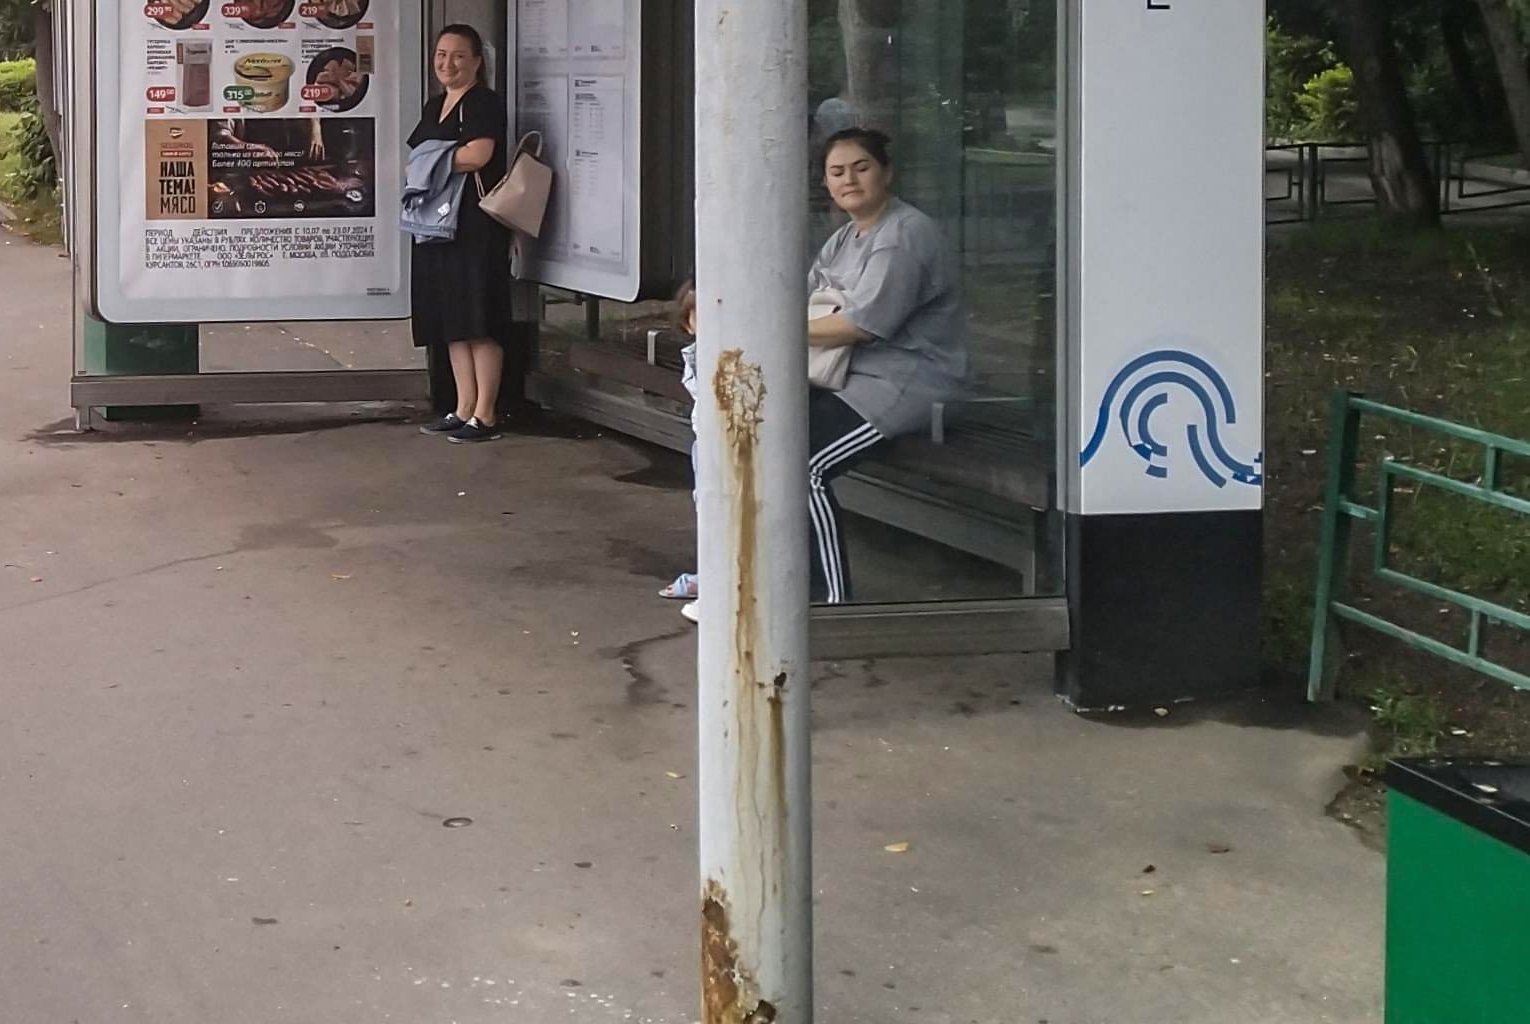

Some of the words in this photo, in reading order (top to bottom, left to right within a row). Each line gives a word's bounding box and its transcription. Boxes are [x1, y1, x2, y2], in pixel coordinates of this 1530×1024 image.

[147, 5, 164, 16] 299
[301, 6, 318, 16] 219
[149, 88, 166, 99] 149
[226, 90, 244, 100] 315
[303, 88, 321, 98] 219
[160, 161, 195, 177] НАША
[159, 179, 196, 195] ТЕМА!
[160, 196, 196, 214] МЯСО
